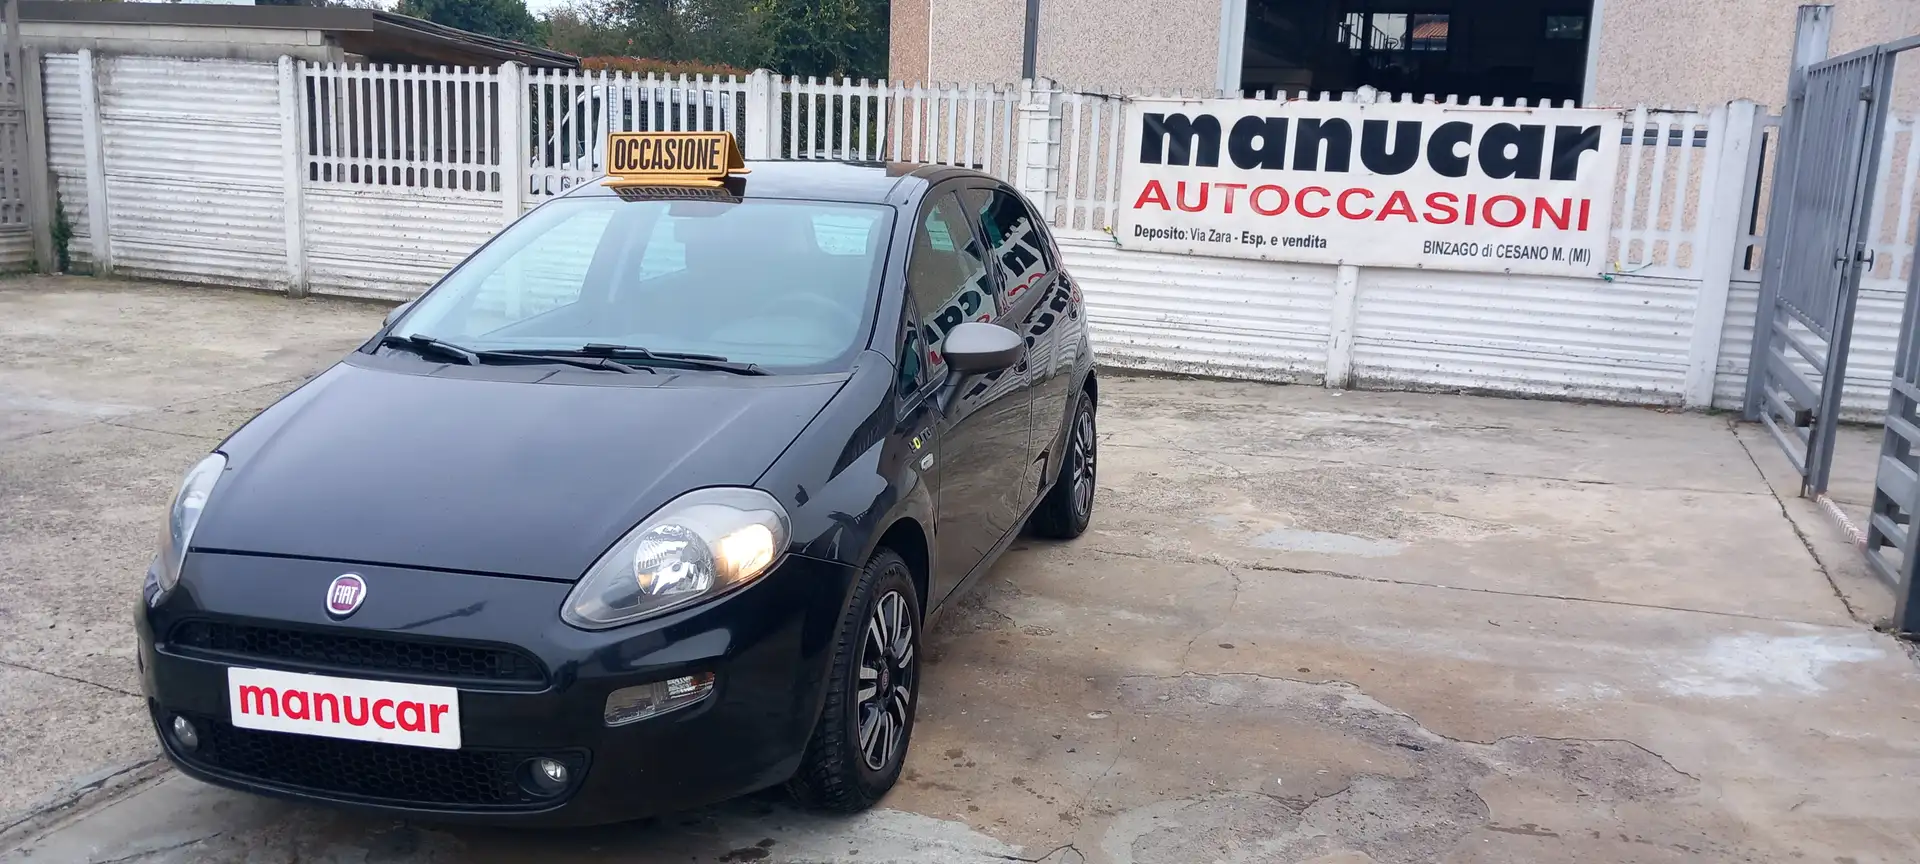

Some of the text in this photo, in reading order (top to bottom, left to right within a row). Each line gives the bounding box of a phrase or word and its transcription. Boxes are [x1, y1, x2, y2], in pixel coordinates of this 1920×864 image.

[614, 138, 721, 170] OCCASIONE
[1139, 112, 1601, 180] manucar
[1133, 179, 1591, 231] AUTOCCASIONI
[1134, 224, 1188, 241] Deposito:
[1190, 227, 1206, 242] Via
[1208, 229, 1232, 243] Zara
[1241, 231, 1267, 248] Esp.
[1270, 235, 1278, 246] e
[1282, 233, 1328, 249] vendita
[1423, 240, 1592, 266] BINZAGO di CESANO M. (MI)
[333, 585, 359, 605] FIAT
[239, 685, 449, 733] manucar
